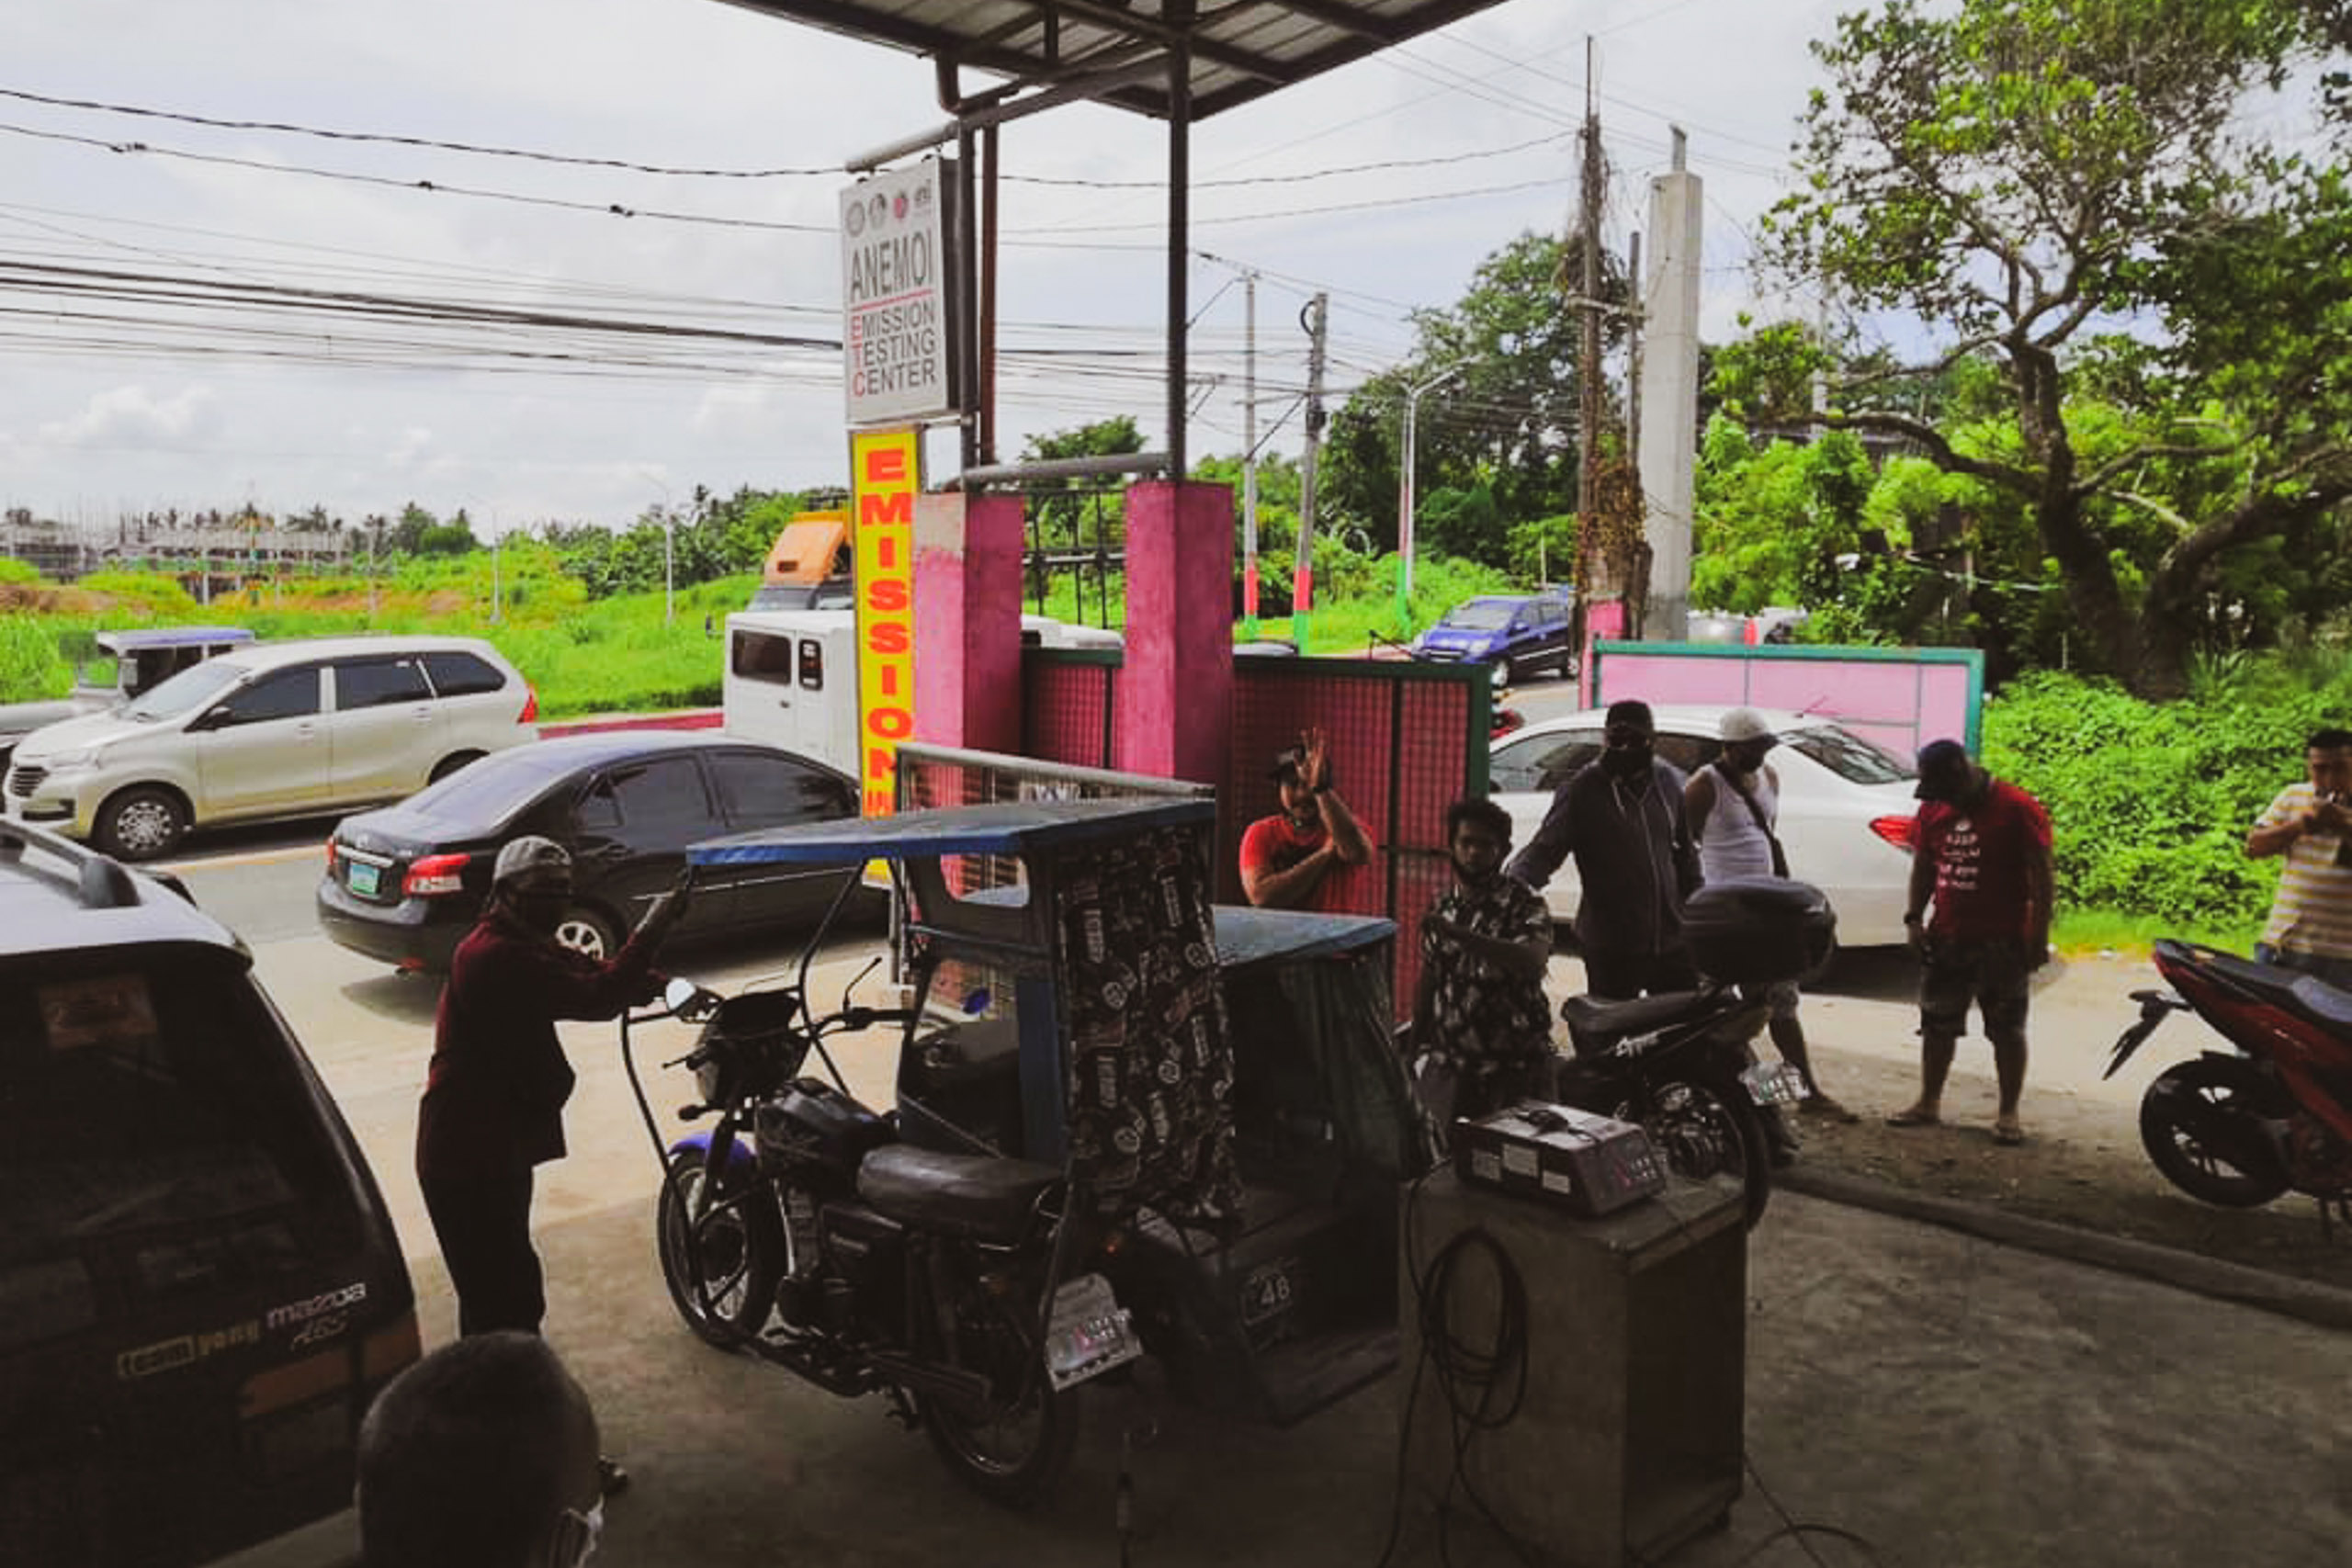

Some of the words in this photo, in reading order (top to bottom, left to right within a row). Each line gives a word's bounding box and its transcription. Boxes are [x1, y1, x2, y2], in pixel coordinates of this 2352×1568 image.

[850, 230, 933, 304] ANEMOI
[851, 299, 935, 341] EMISSION
[851, 328, 935, 369] TESTING
[852, 358, 936, 398] CENTER
